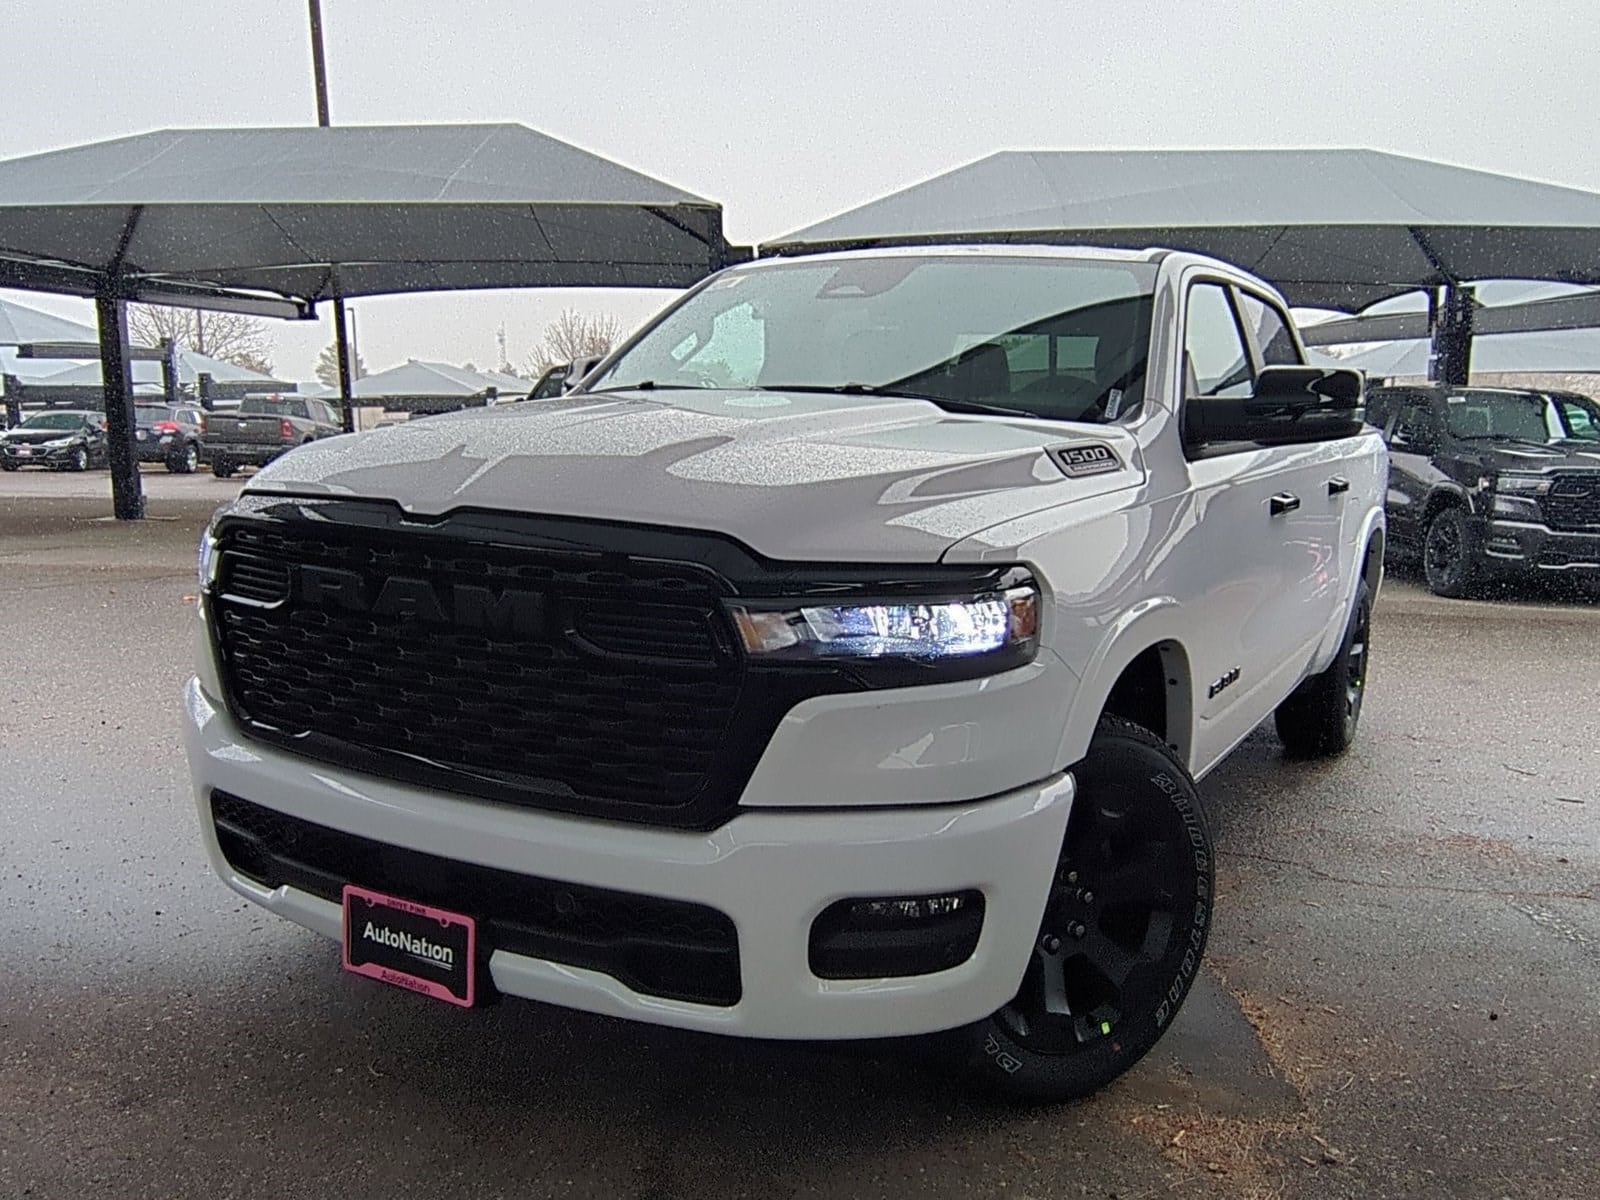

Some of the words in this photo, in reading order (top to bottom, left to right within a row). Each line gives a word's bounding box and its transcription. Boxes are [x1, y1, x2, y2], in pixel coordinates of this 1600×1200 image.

[1061, 447, 1109, 465] 1500
[299, 564, 546, 632] RAM
[363, 921, 454, 963] AutoNation
